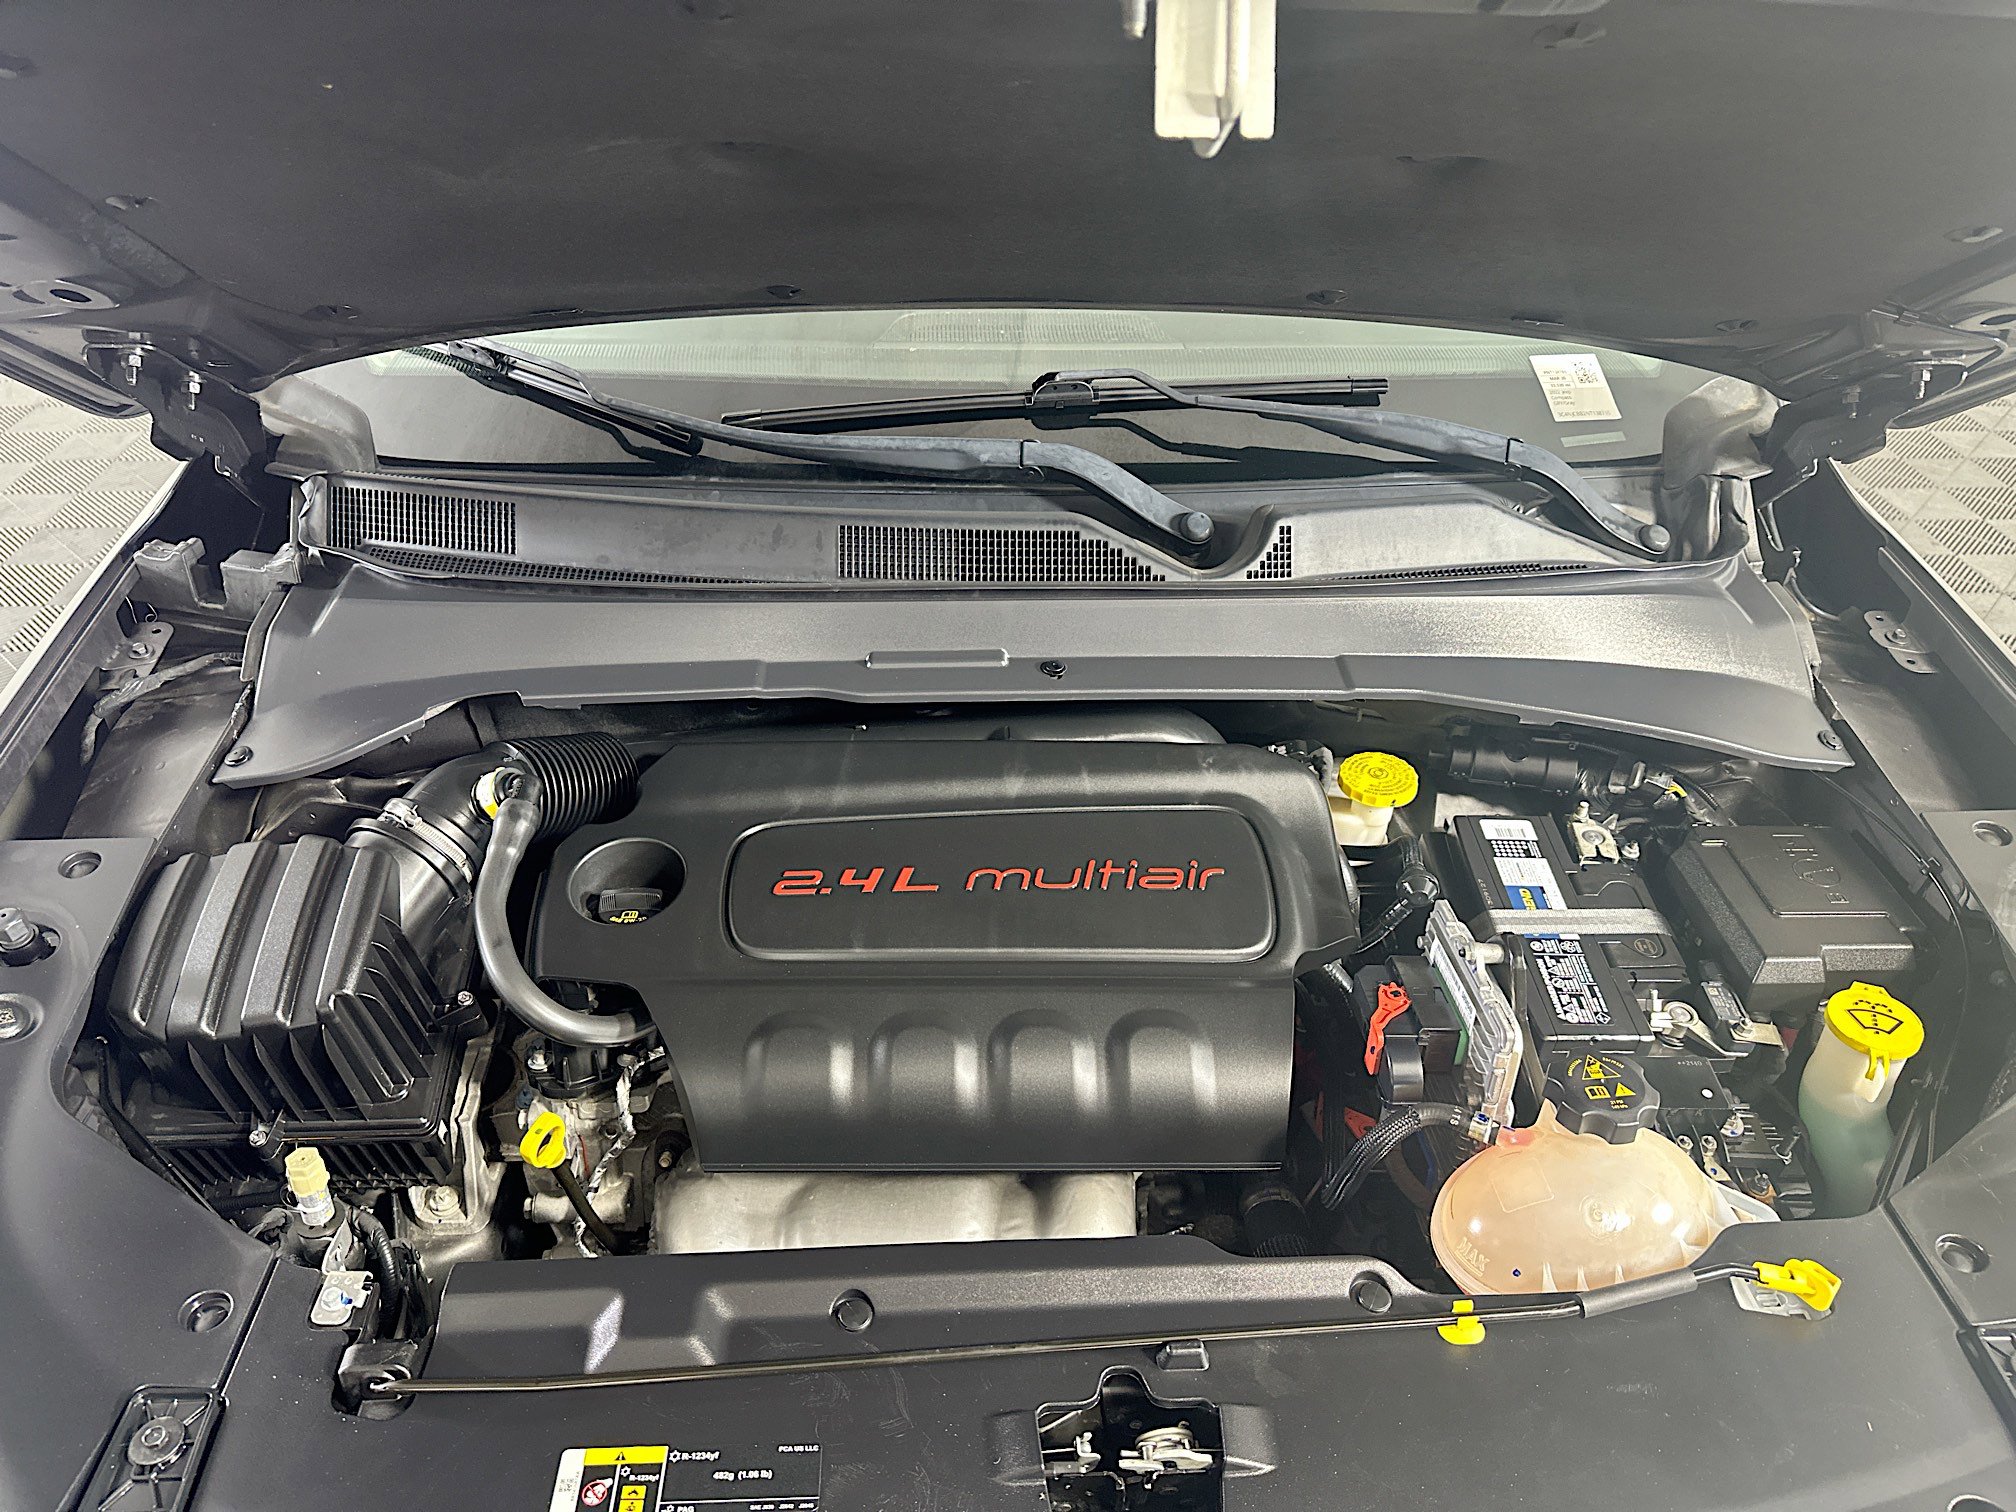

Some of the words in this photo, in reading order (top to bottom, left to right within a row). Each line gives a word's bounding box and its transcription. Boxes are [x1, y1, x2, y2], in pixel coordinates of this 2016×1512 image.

[965, 859, 1225, 892] multiair
[1456, 1236, 1490, 1272] MAX
[804, 1444, 820, 1452] LLC
[681, 1450, 720, 1462] R-1234yf
[760, 1469, 773, 1480] lb)
